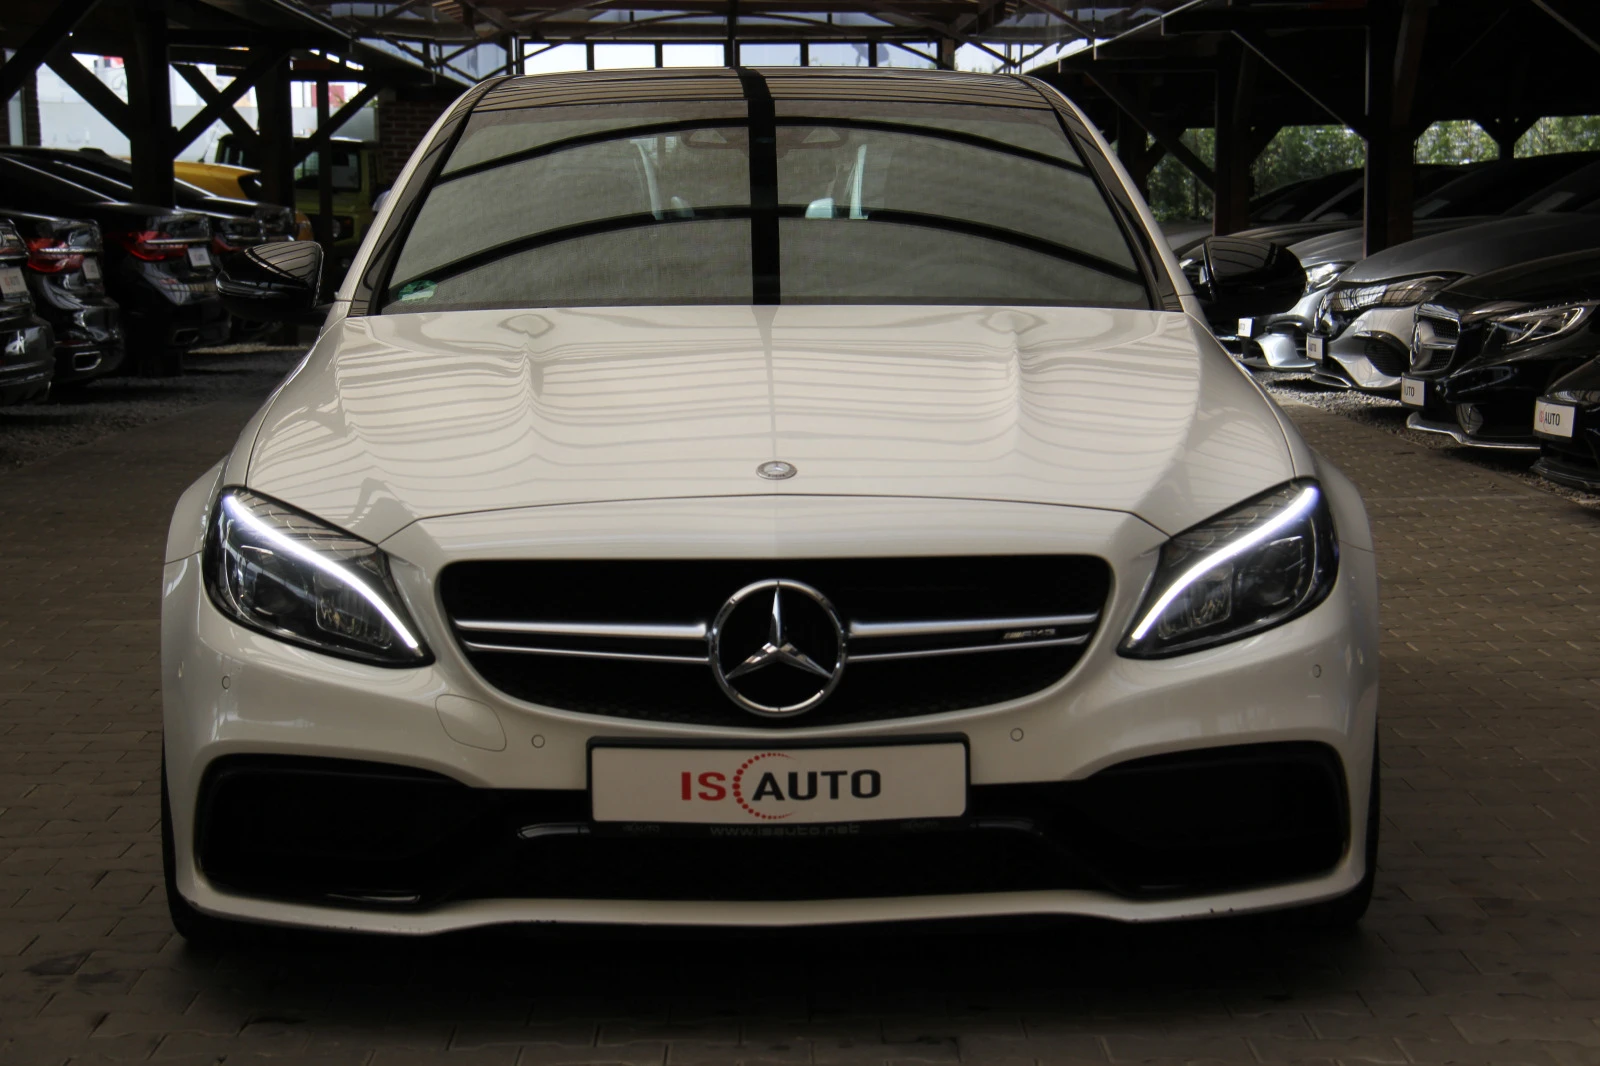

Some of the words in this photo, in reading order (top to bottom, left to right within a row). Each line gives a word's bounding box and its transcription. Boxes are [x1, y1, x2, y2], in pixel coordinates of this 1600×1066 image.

[1545, 411, 1561, 426] AUTO
[681, 771, 726, 800] IS
[752, 769, 881, 801] AUTO
